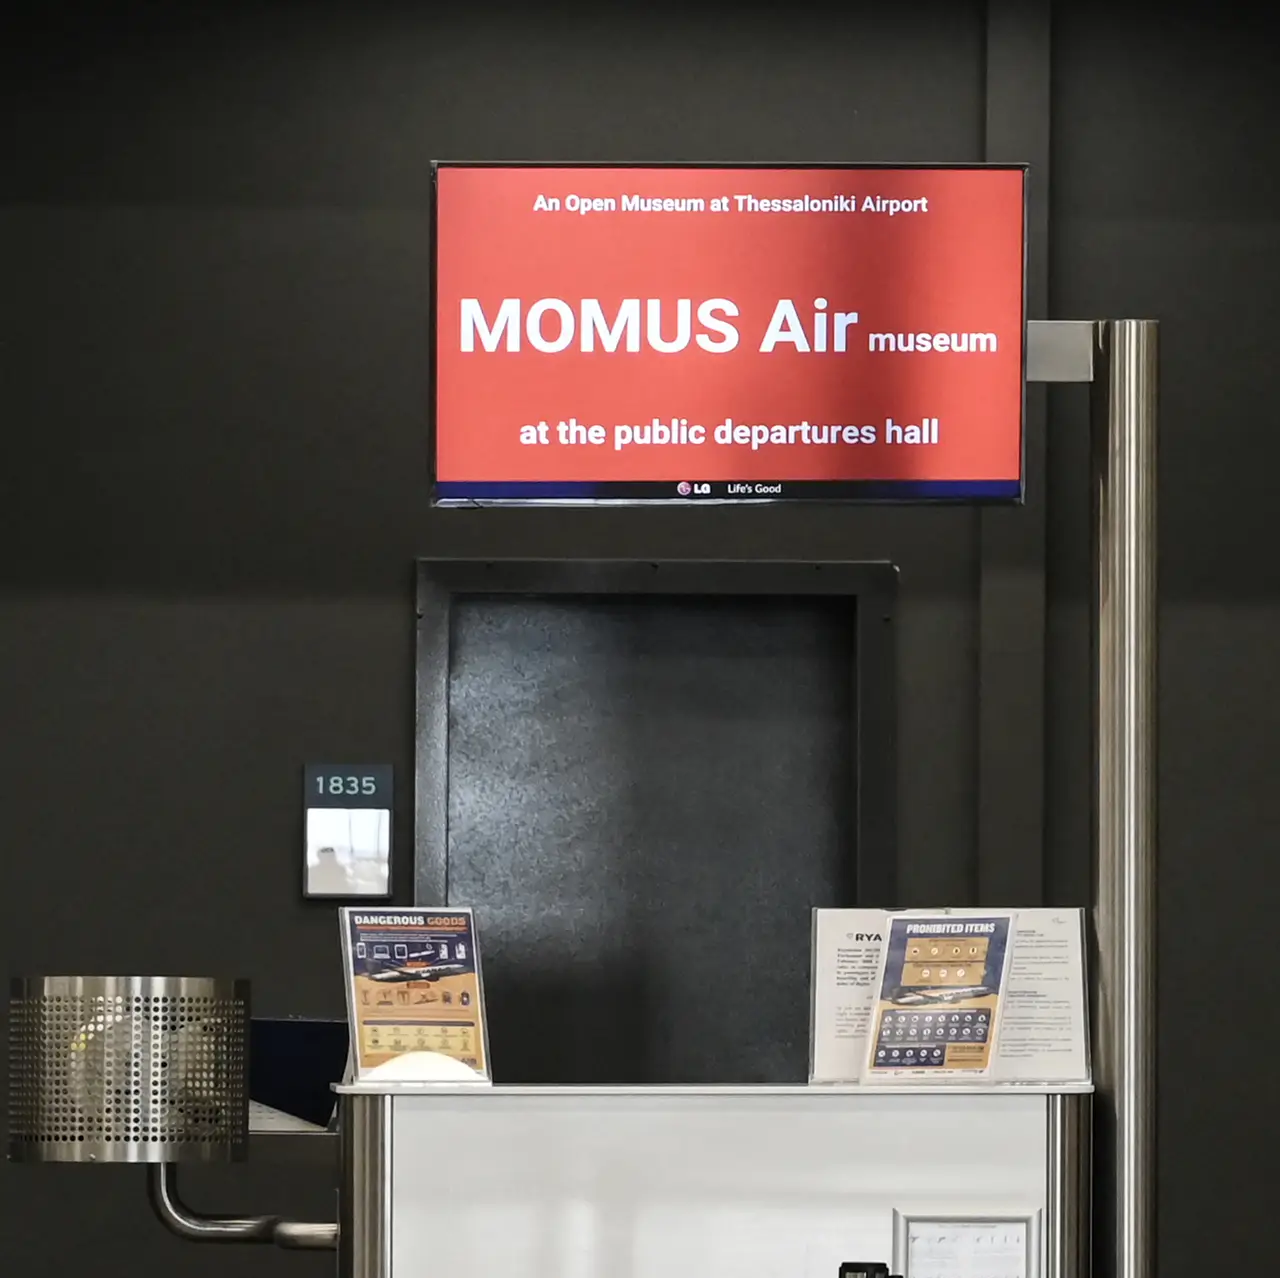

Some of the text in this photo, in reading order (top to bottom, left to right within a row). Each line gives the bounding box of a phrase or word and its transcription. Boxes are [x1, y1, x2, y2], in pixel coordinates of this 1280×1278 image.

[533, 195, 928, 216] An Open Museum at Thessaloniki Airport
[459, 297, 998, 354] MOMUS Air museum
[519, 419, 939, 451] at the public departures hall
[694, 483, 711, 494] LG
[727, 483, 782, 494] Life's Good
[316, 776, 376, 795] 1835
[354, 915, 466, 926] DANGEROUS GOODS
[906, 923, 996, 934] PROHIBITED ITEMS
